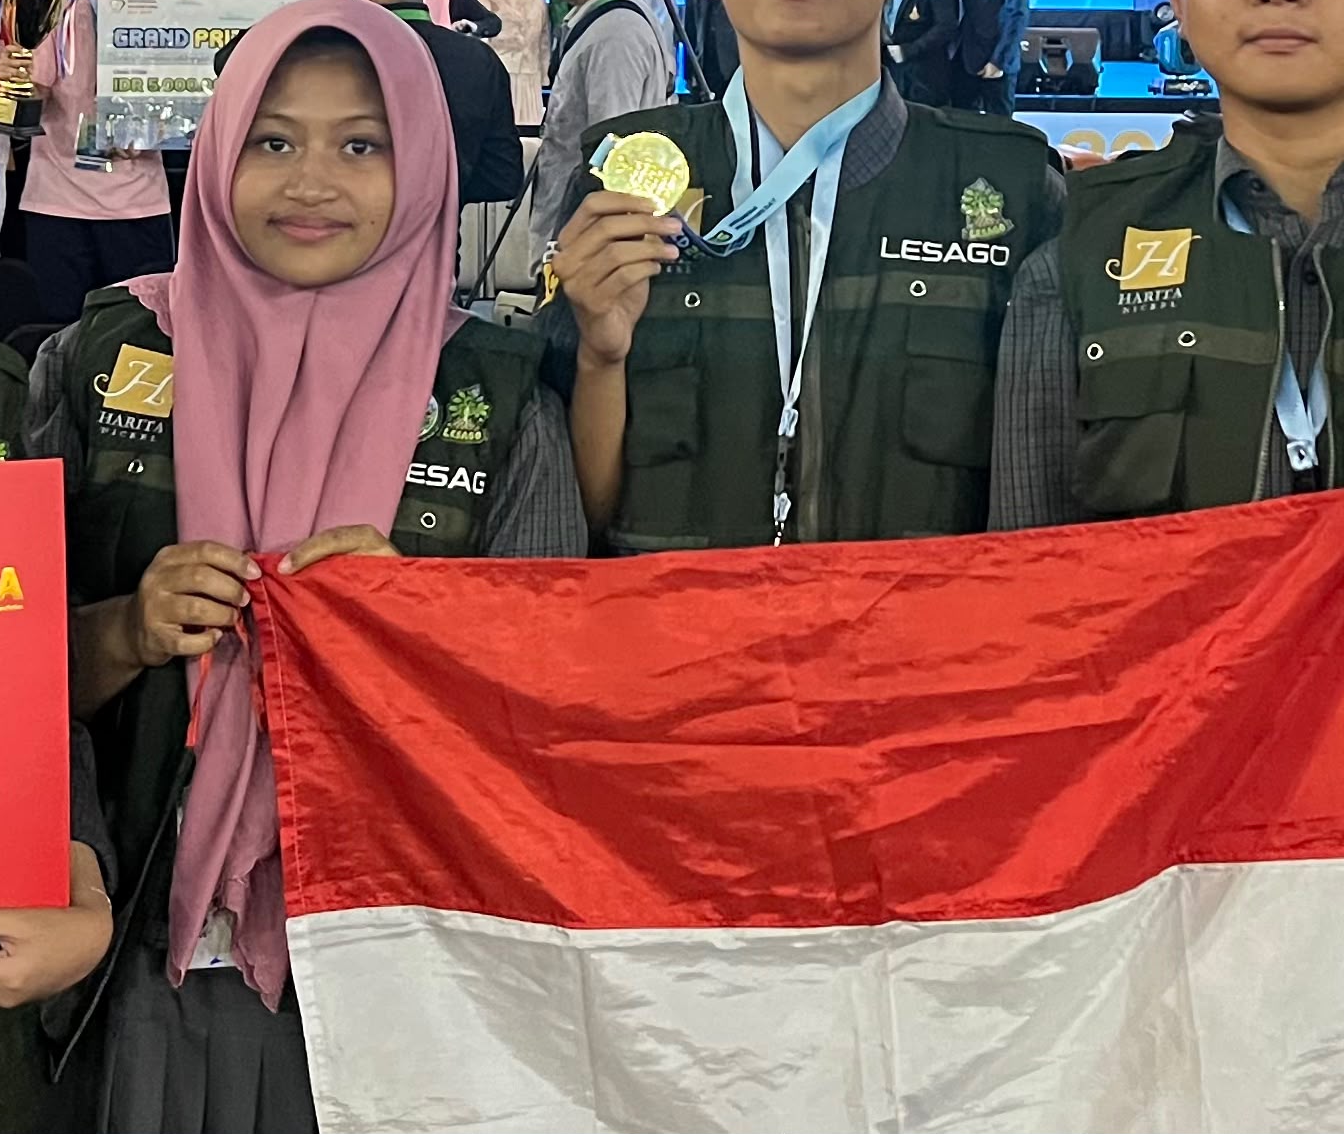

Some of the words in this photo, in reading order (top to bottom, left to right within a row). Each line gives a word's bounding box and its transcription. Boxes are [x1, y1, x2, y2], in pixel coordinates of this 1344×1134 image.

[113, 28, 190, 48] GRAND
[112, 77, 144, 93] IDR
[880, 236, 1010, 266] LESAGO
[1118, 287, 1182, 306] HARITA
[97, 410, 164, 434] HARITA
[405, 463, 487, 494] ESAG
